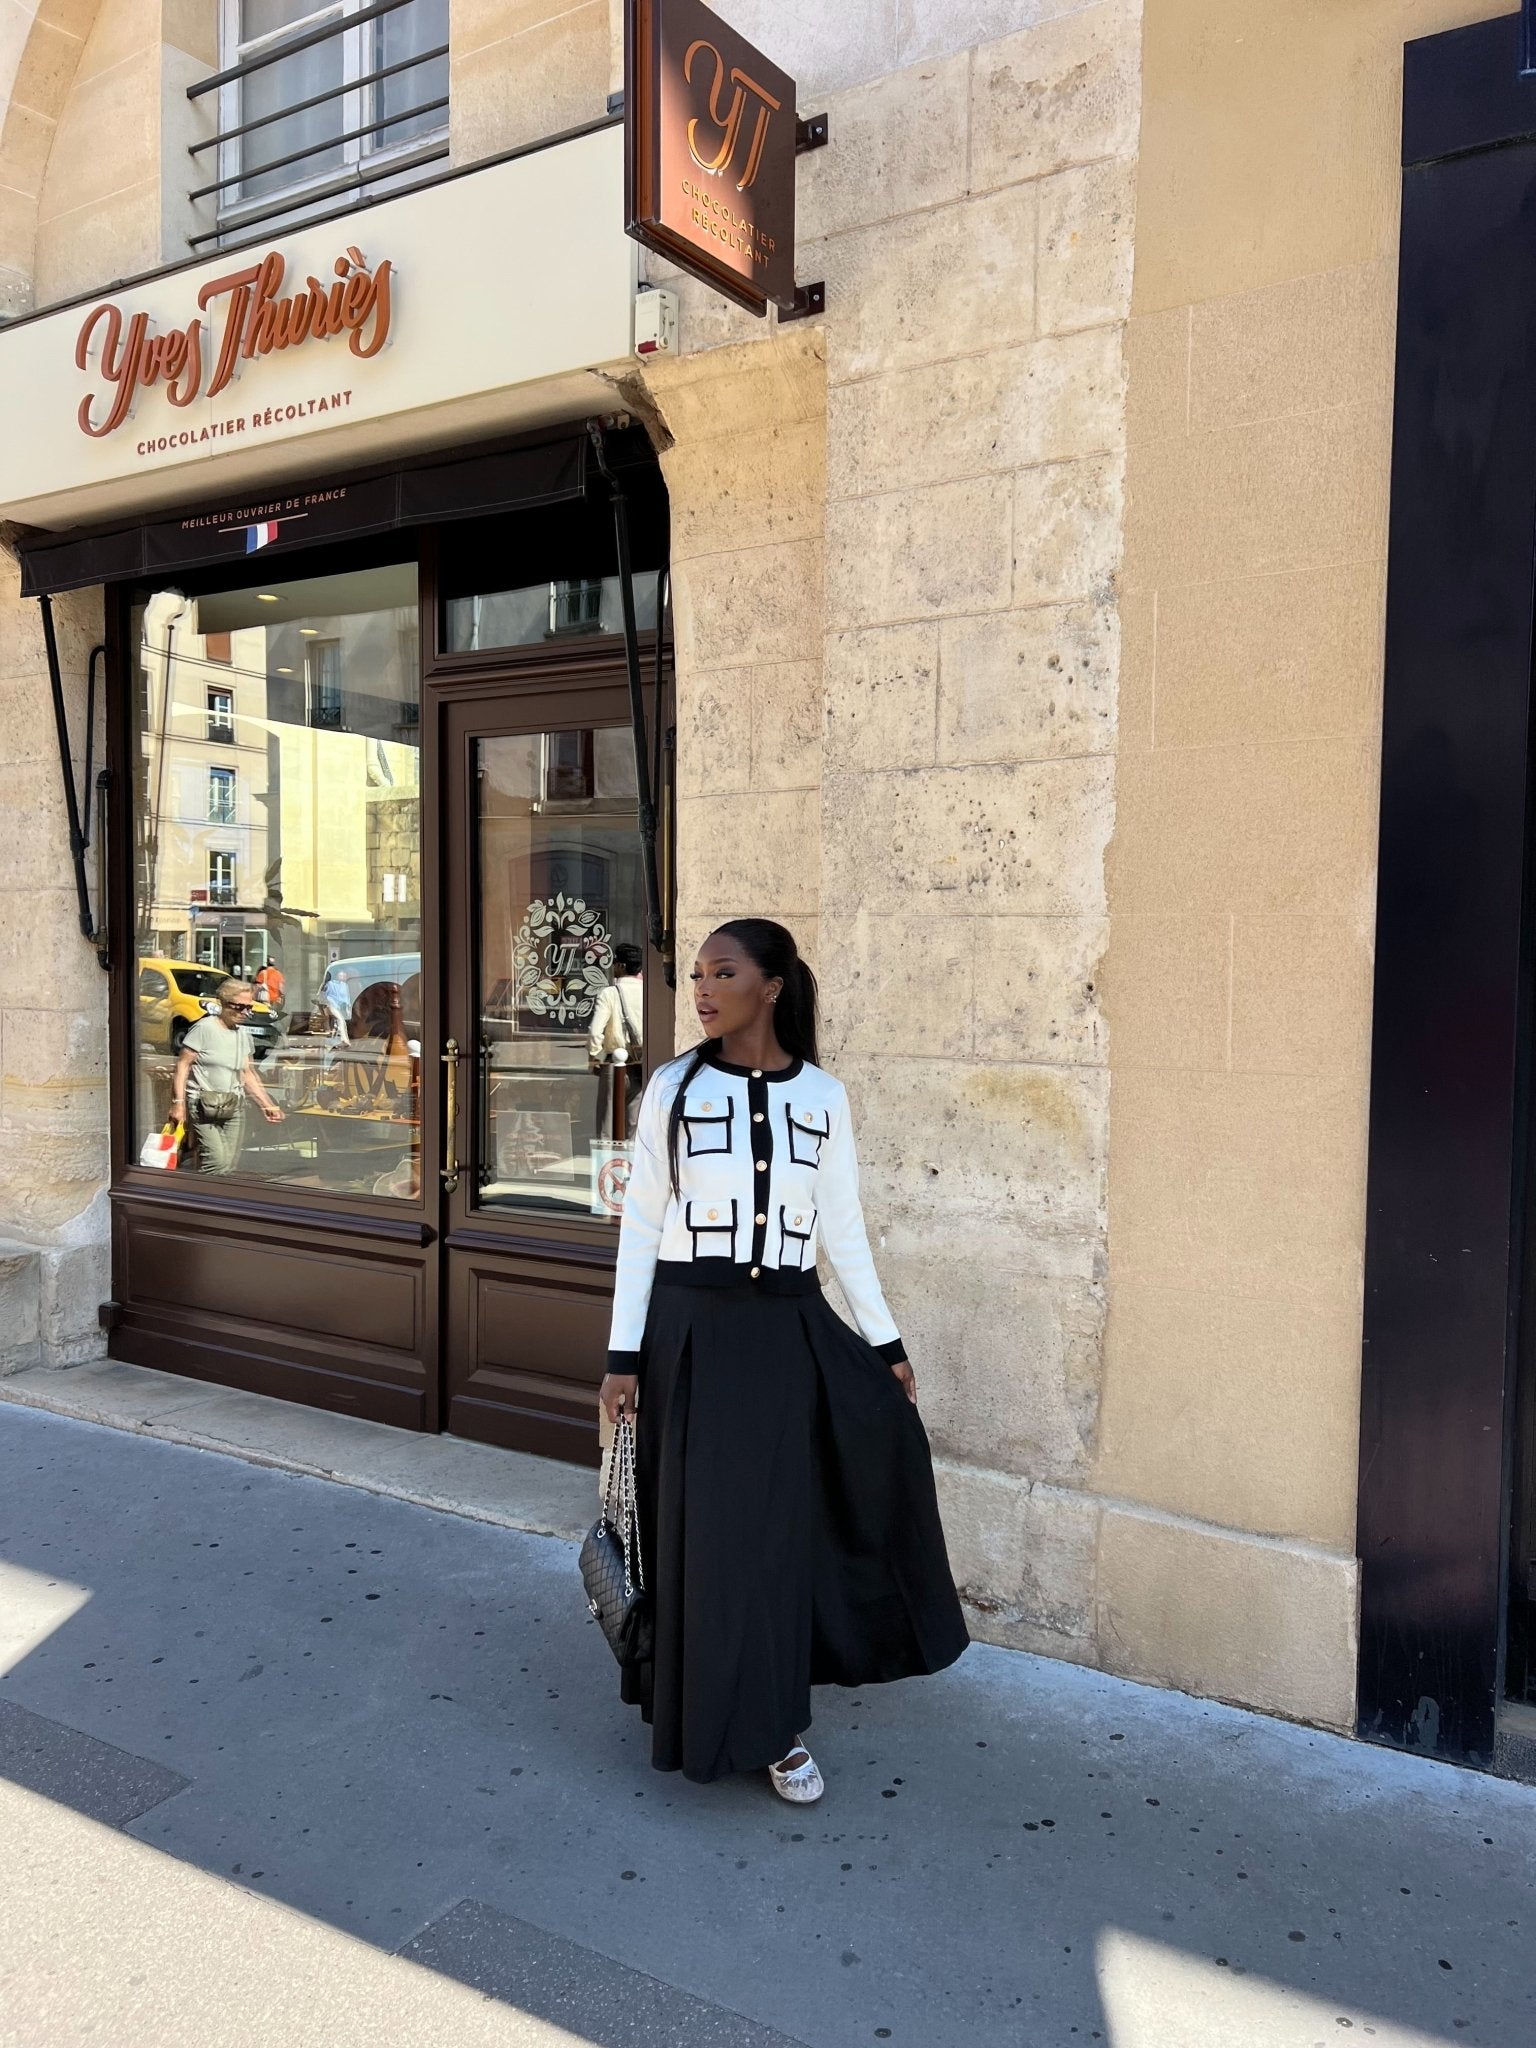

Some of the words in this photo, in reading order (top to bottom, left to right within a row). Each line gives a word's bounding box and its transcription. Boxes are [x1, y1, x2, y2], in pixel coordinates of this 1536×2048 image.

[681, 178, 776, 253] CHOCOLATIER
[691, 206, 770, 268] RÉCOLTANT
[75, 303, 202, 437] Yves
[198, 246, 392, 398] Thuriès
[137, 417, 246, 456] CHOCOLATIER
[252, 390, 353, 428] RÉCOLTANT
[181, 511, 234, 530] MEILLEUR
[236, 502, 282, 519] OUVRIER
[285, 498, 301, 510] DE
[304, 487, 348, 506] FRANCE
